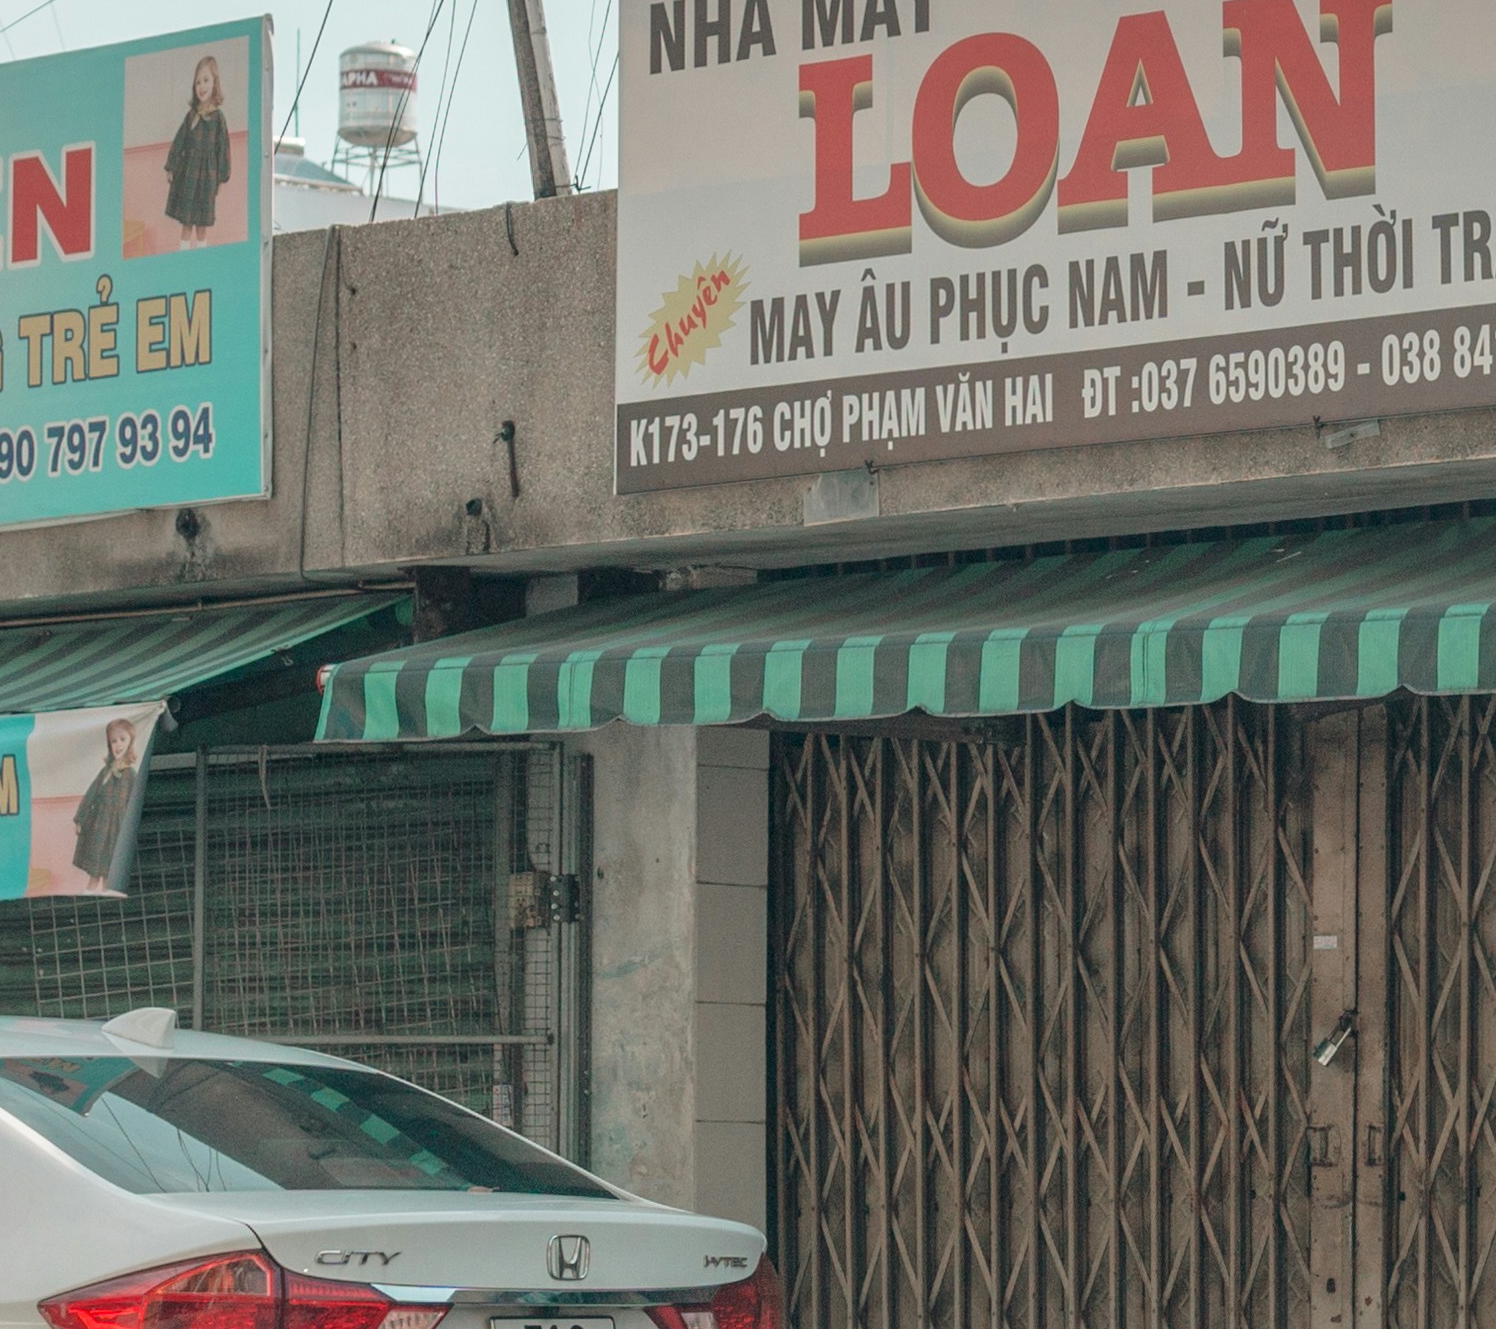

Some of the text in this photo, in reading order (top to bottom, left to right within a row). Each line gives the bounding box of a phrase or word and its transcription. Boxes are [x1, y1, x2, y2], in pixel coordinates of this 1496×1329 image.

[19, 274, 119, 386] TRẺ
[136, 289, 212, 372] EM
[649, 270, 730, 375] Chuyên
[750, 286, 842, 366] MAY
[855, 267, 911, 353] ÂU
[930, 262, 1050, 360] PHỤC
[1068, 250, 1169, 329] NAM
[1222, 219, 1289, 311] NỮ
[1301, 202, 1413, 301] THỜI
[47, 422, 108, 472] 797
[119, 414, 159, 465] 93
[170, 404, 213, 459] 94
[630, 402, 763, 468] K173-176
[773, 389, 836, 457] CHỢ
[842, 387, 925, 450] PHẠM
[935, 374, 994, 434] VĂN
[1003, 372, 1053, 430] HAI
[1081, 366, 1123, 418] ĐT
[1209, 341, 1344, 406] 6590389
[1381, 329, 1441, 387] 038
[315, 1249, 401, 1265] CITY
